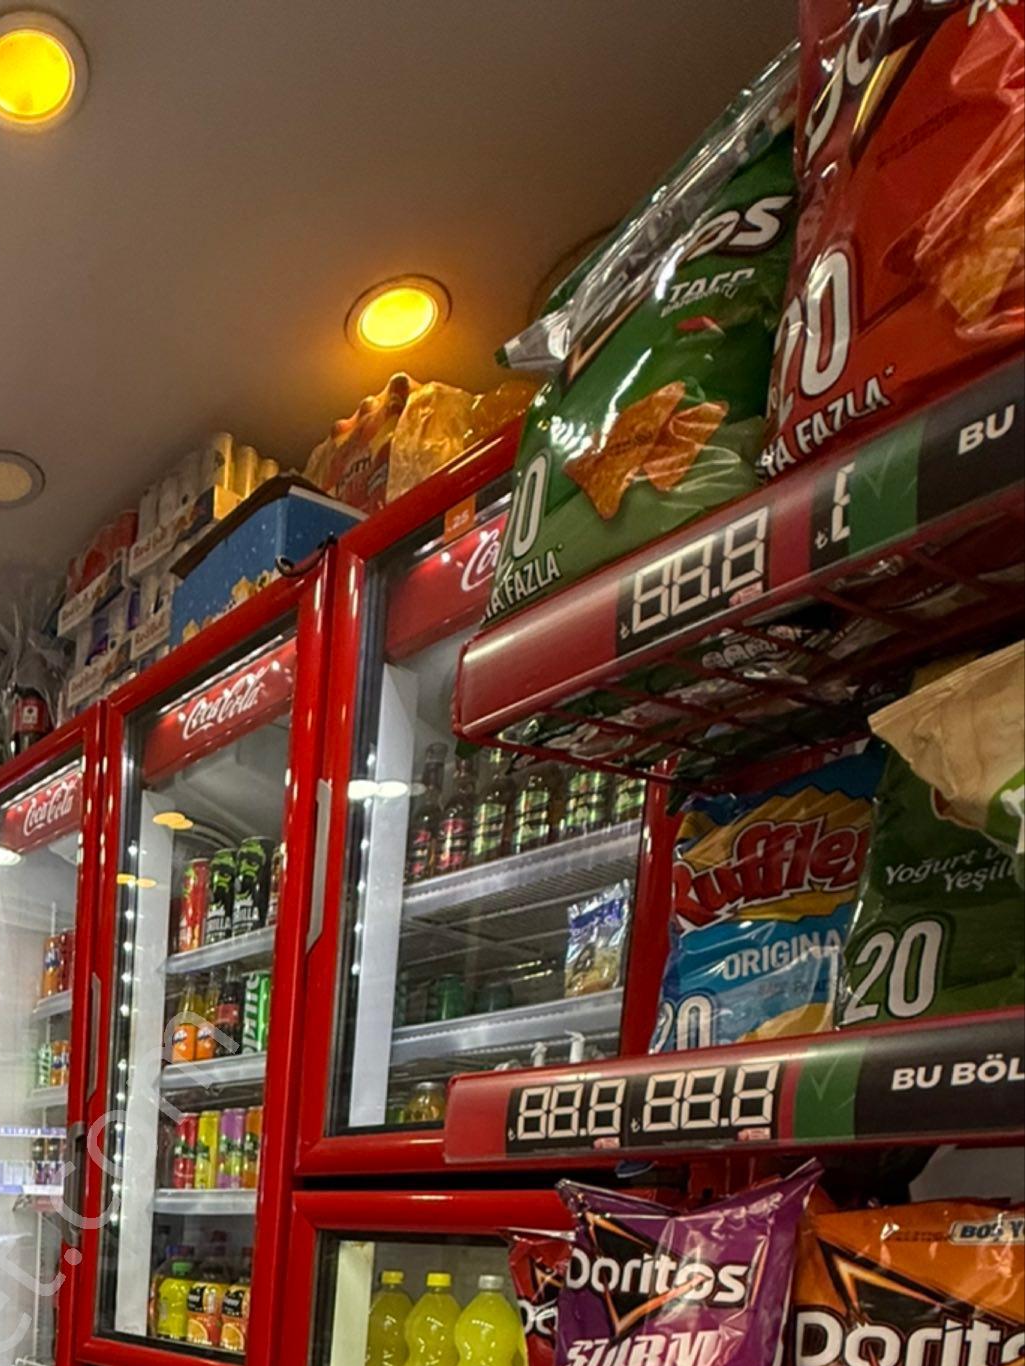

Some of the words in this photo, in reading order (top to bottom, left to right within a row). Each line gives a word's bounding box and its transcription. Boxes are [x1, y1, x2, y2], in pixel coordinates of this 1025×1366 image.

[958, 404, 1014, 455] BU
[885, 849, 978, 886] Yoğurt
[721, 928, 842, 981] ORIGINA
[840, 919, 943, 1026] 20
[891, 1063, 942, 1092] BU
[950, 1053, 1025, 1087] BÖL
[566, 1247, 750, 1303] Doritos
